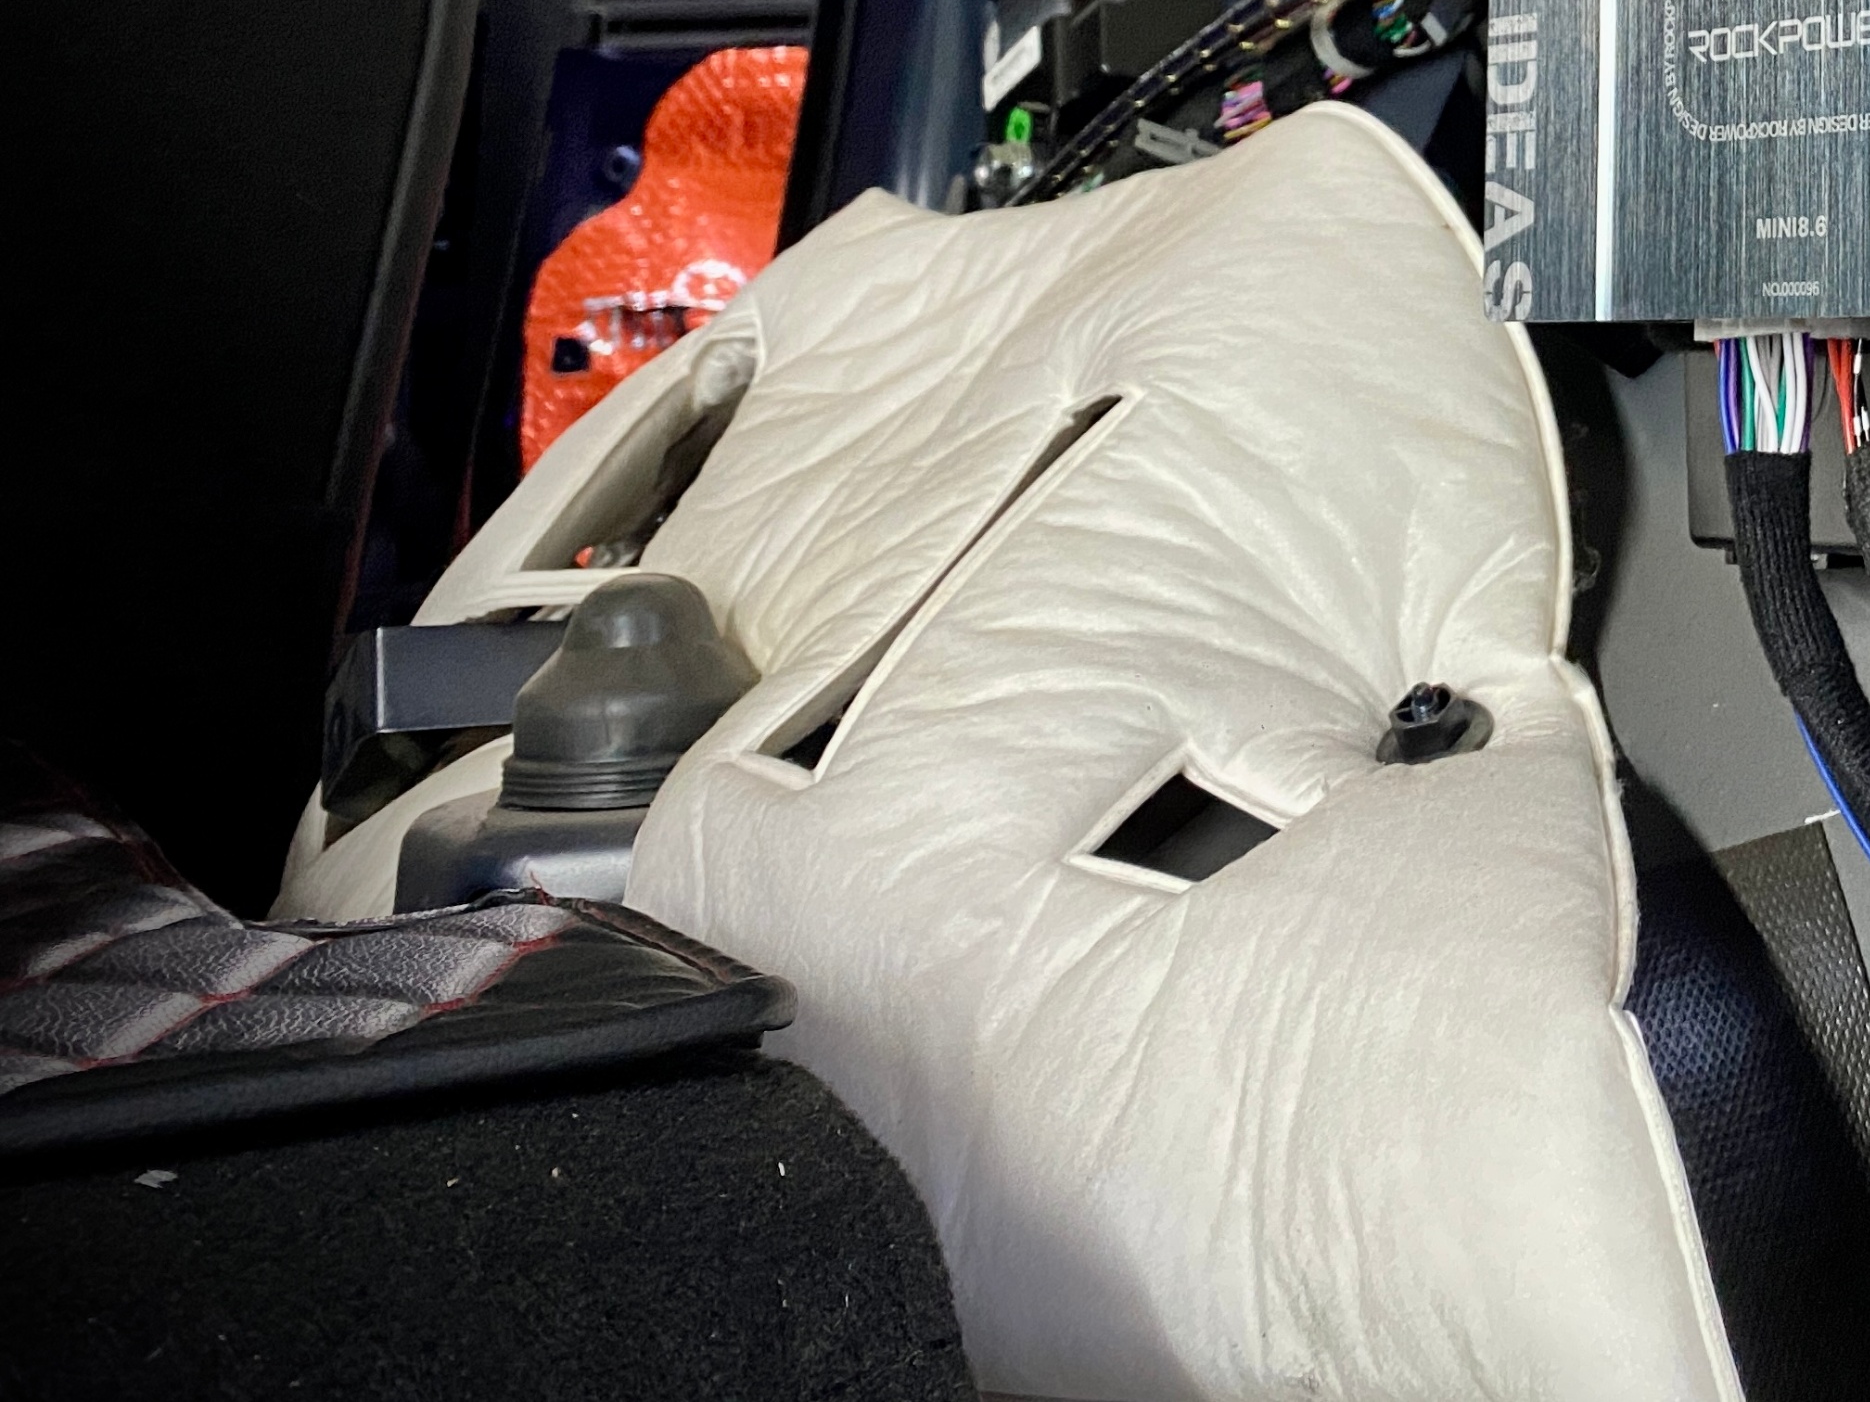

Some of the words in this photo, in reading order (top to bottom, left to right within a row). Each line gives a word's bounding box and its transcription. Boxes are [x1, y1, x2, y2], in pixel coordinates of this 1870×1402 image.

[1664, 61, 1676, 87] BY
[1709, 119, 1788, 142] ROCKPOWER
[1789, 118, 1806, 137] BY
[1808, 113, 1858, 134] DESIGN
[1484, 12, 1538, 321] IDEAS
[1756, 215, 1827, 239] MINI8.6
